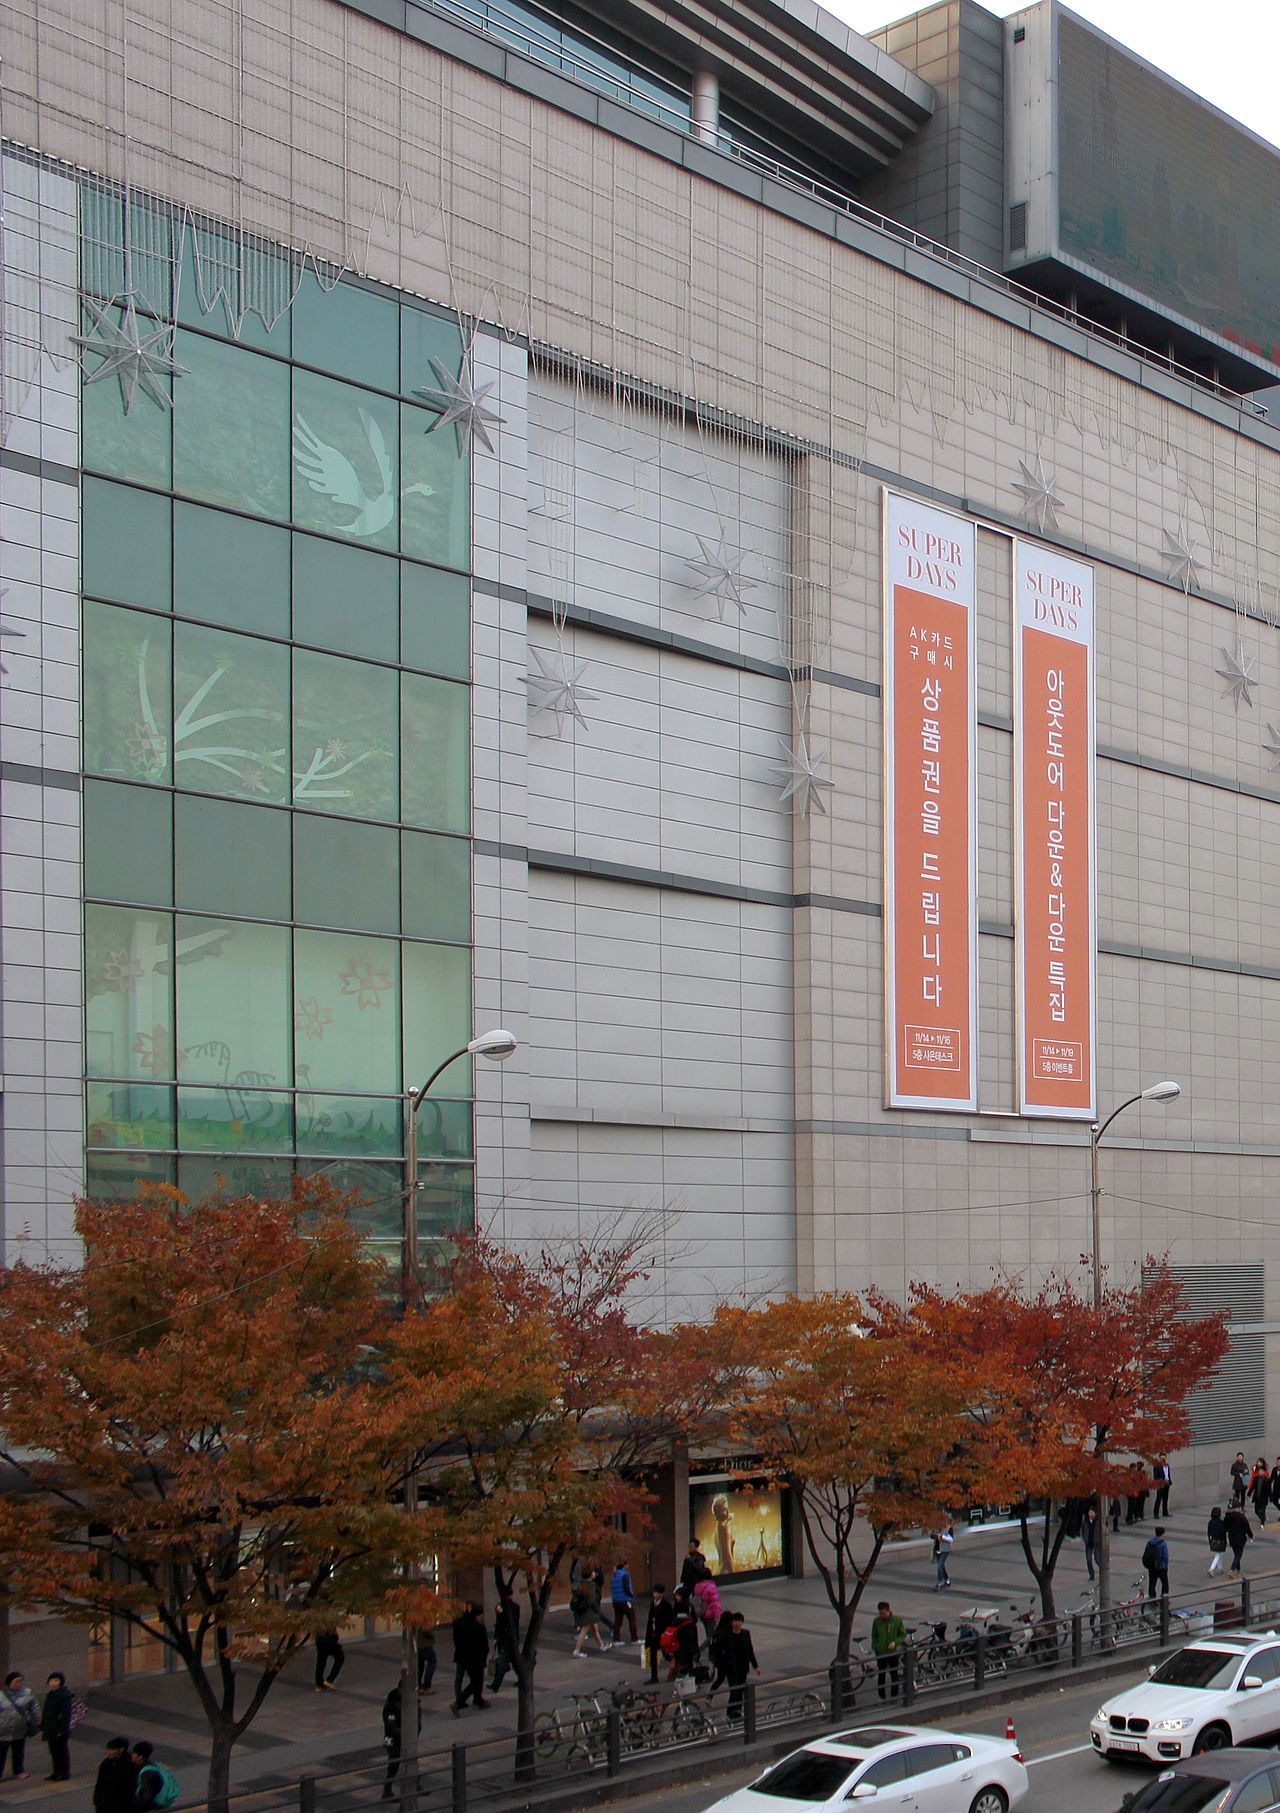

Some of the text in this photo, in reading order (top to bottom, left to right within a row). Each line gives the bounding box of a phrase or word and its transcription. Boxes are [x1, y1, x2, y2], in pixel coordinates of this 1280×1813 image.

[897, 523, 964, 568] SUPER
[905, 555, 957, 592] DAYS
[1024, 570, 1084, 608] SUPER
[1033, 598, 1079, 632] DAYS
[909, 625, 954, 650] AK카드
[920, 677, 944, 1008] 상품권을 드립니다
[1045, 669, 1066, 1023] 아웃도어 다운&다운 특집
[914, 1032, 930, 1043] 11/14
